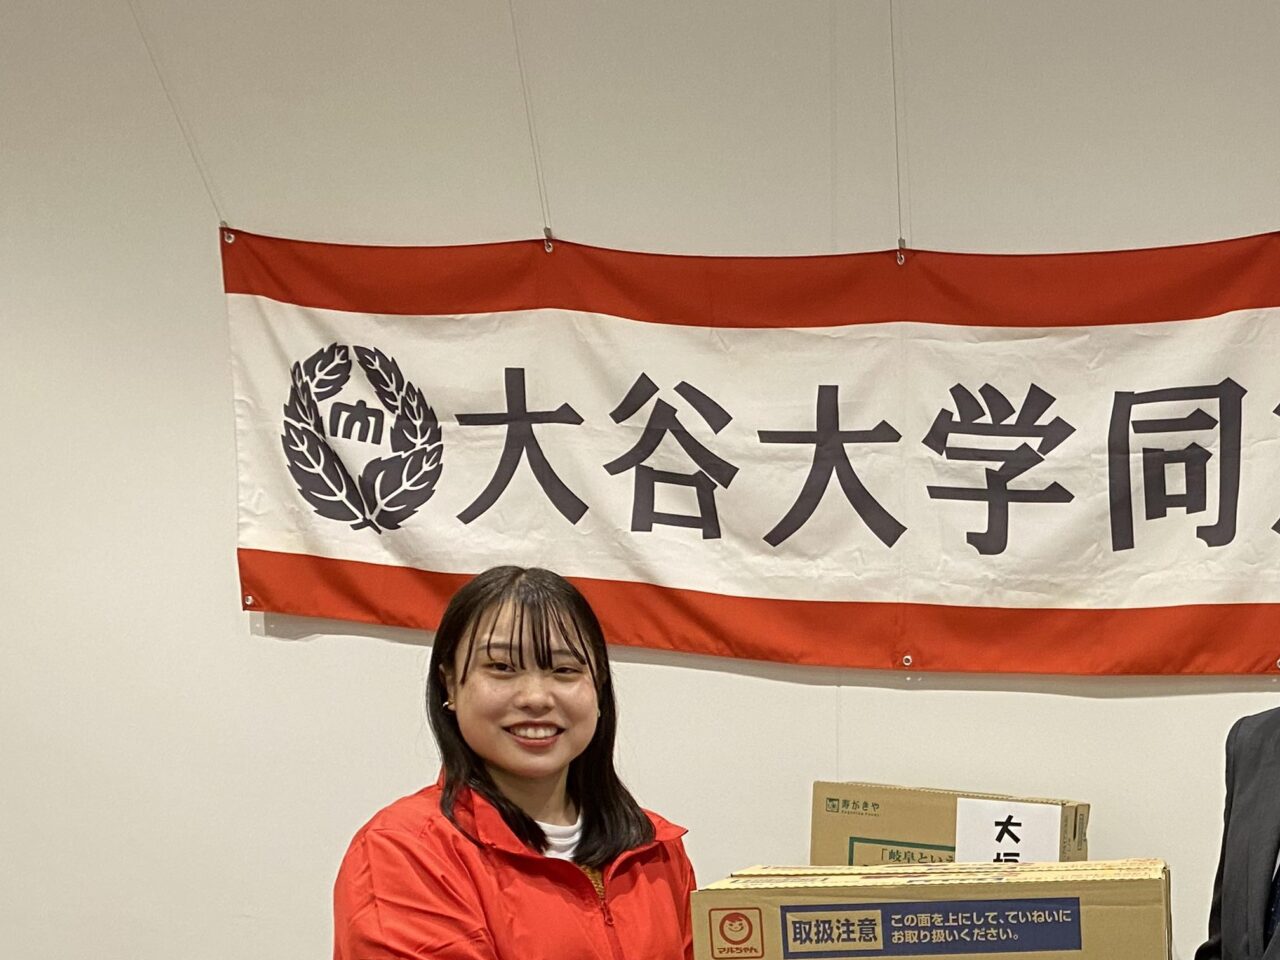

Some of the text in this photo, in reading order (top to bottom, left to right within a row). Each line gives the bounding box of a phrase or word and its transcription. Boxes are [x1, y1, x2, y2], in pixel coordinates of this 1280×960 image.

[890, 908, 1073, 927] この面を上にして、ていねいに
[791, 917, 879, 946] 取扱注意
[891, 924, 1021, 945] お取り扱いください。
[716, 946, 758, 956] マルちゃん
